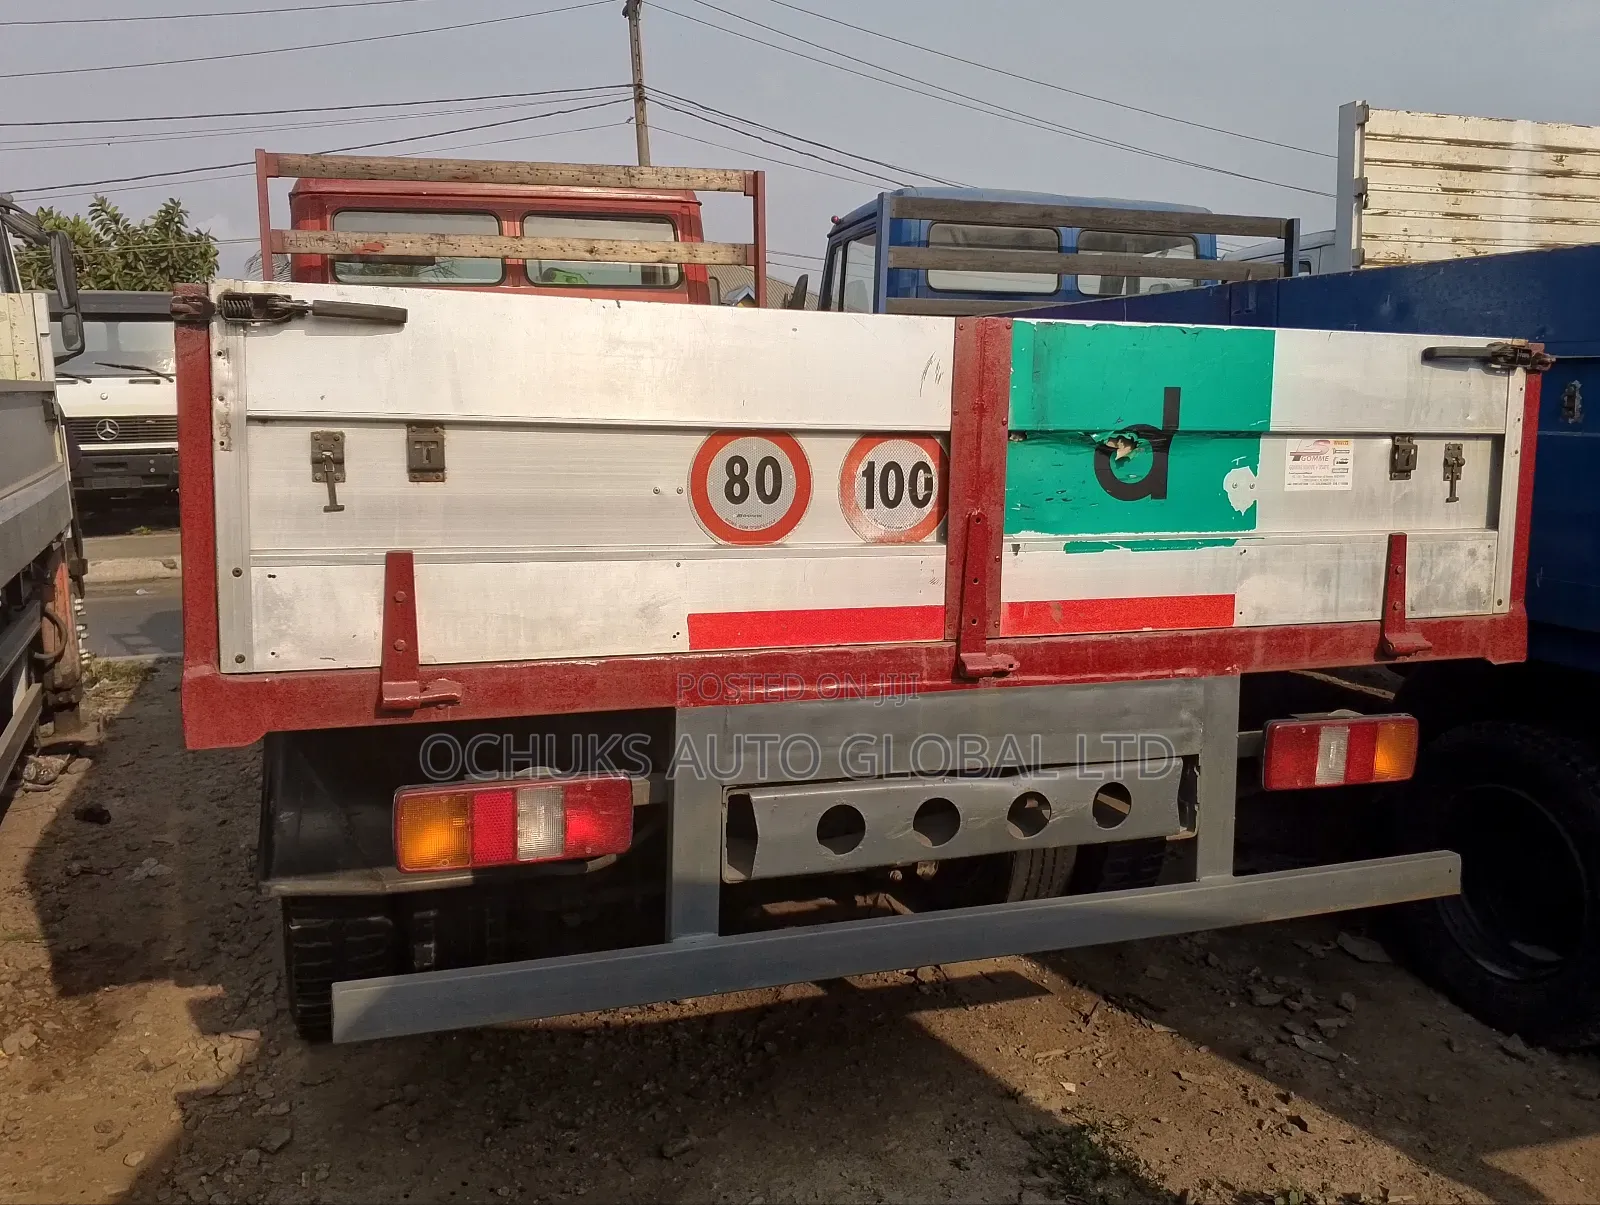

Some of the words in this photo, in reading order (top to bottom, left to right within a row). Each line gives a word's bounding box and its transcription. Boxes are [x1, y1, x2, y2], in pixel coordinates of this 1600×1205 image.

[1094, 387, 1181, 501] d
[724, 455, 782, 505] 80
[862, 461, 933, 510] 100
